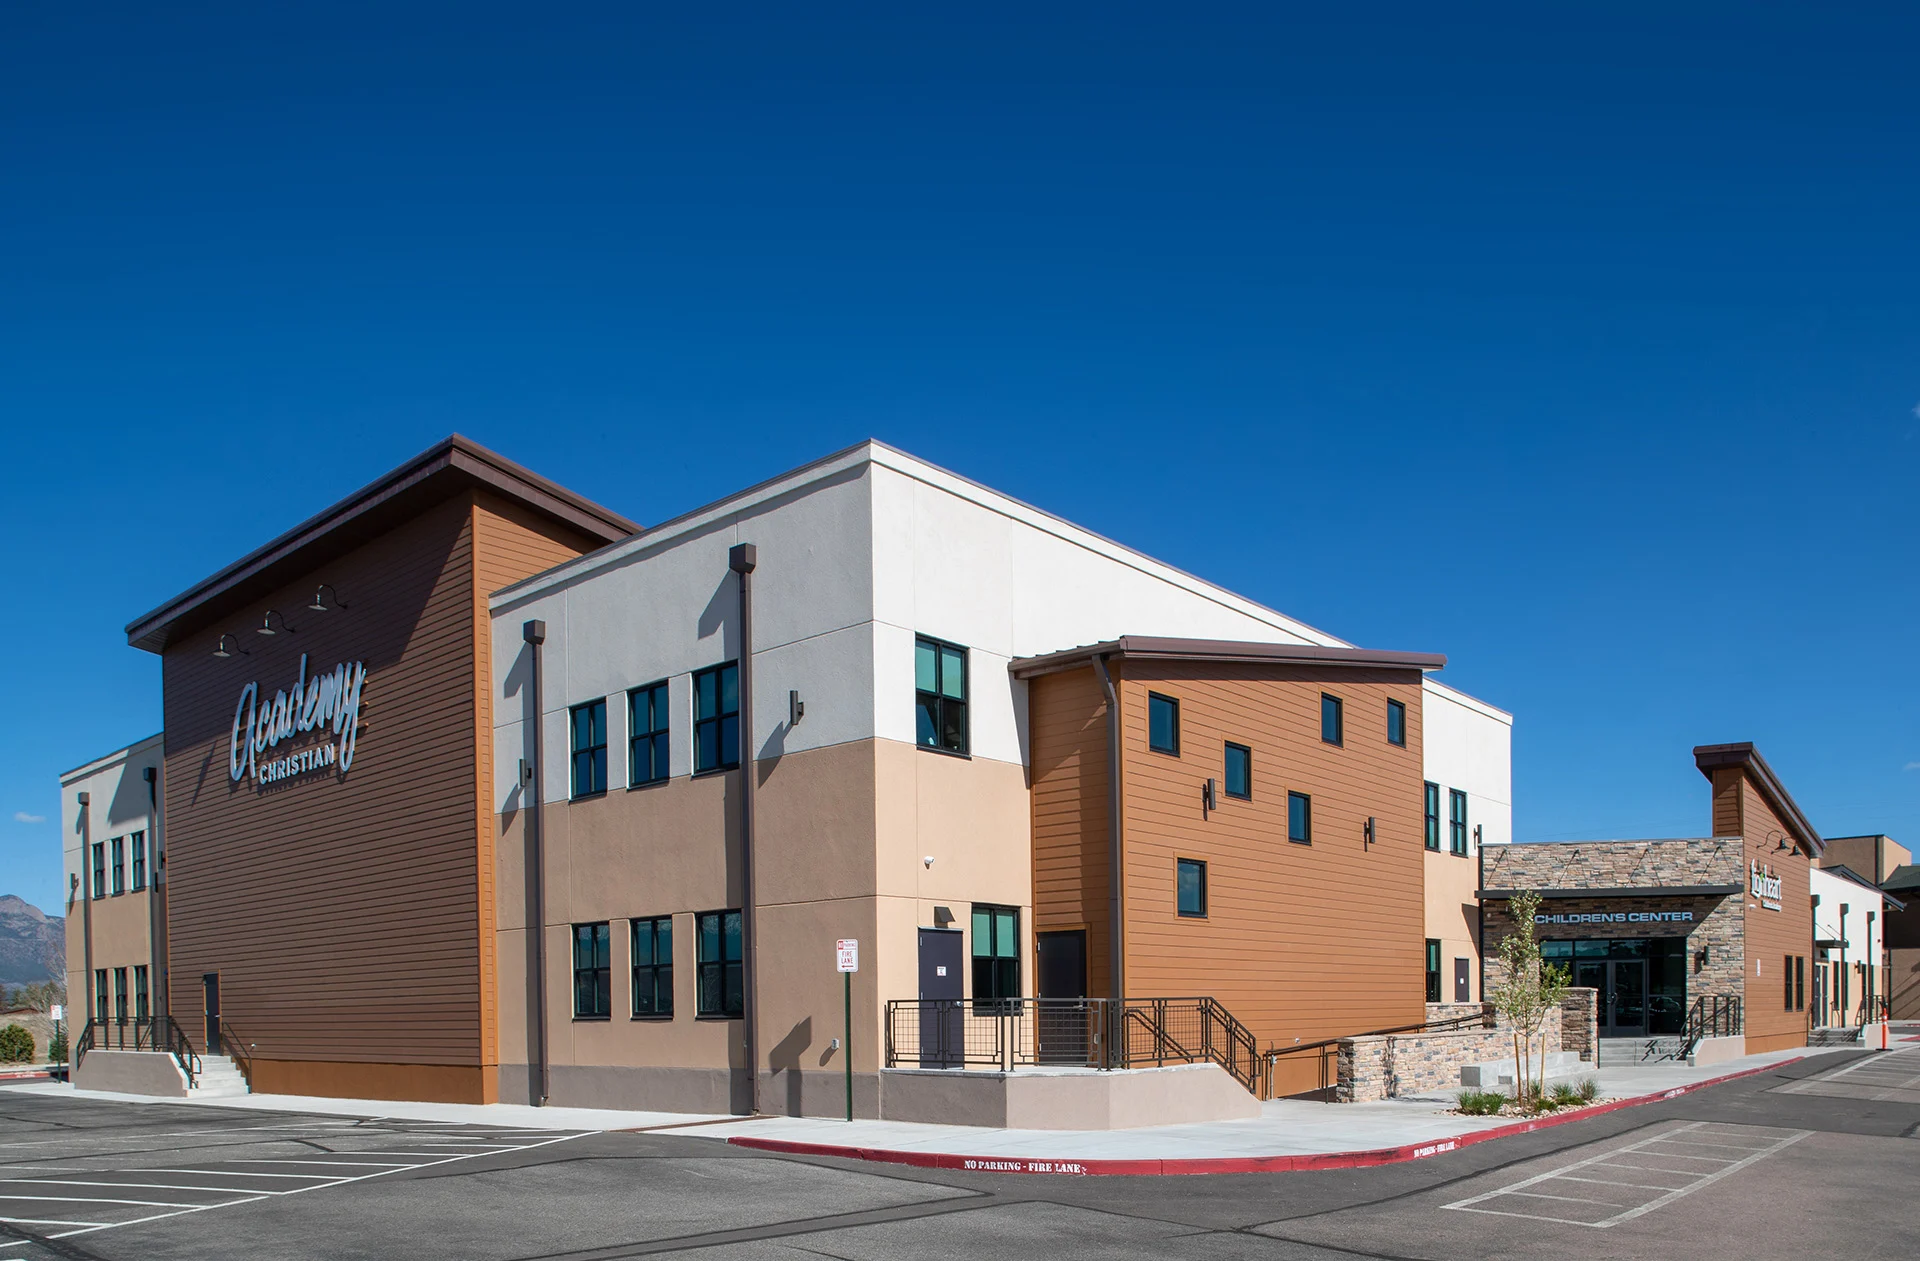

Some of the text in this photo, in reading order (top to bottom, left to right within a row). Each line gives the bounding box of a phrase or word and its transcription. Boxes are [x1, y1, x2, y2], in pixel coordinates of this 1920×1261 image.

[230, 653, 367, 780] Academy
[260, 743, 335, 785] CHRISTIAN
[1534, 911, 1693, 924] CHILDREN'S CENTER
[964, 1160, 977, 1170] NO
[978, 1160, 1021, 1171] PARKING
[1028, 1162, 1052, 1172] FIRE
[1055, 1163, 1080, 1173] LANE
